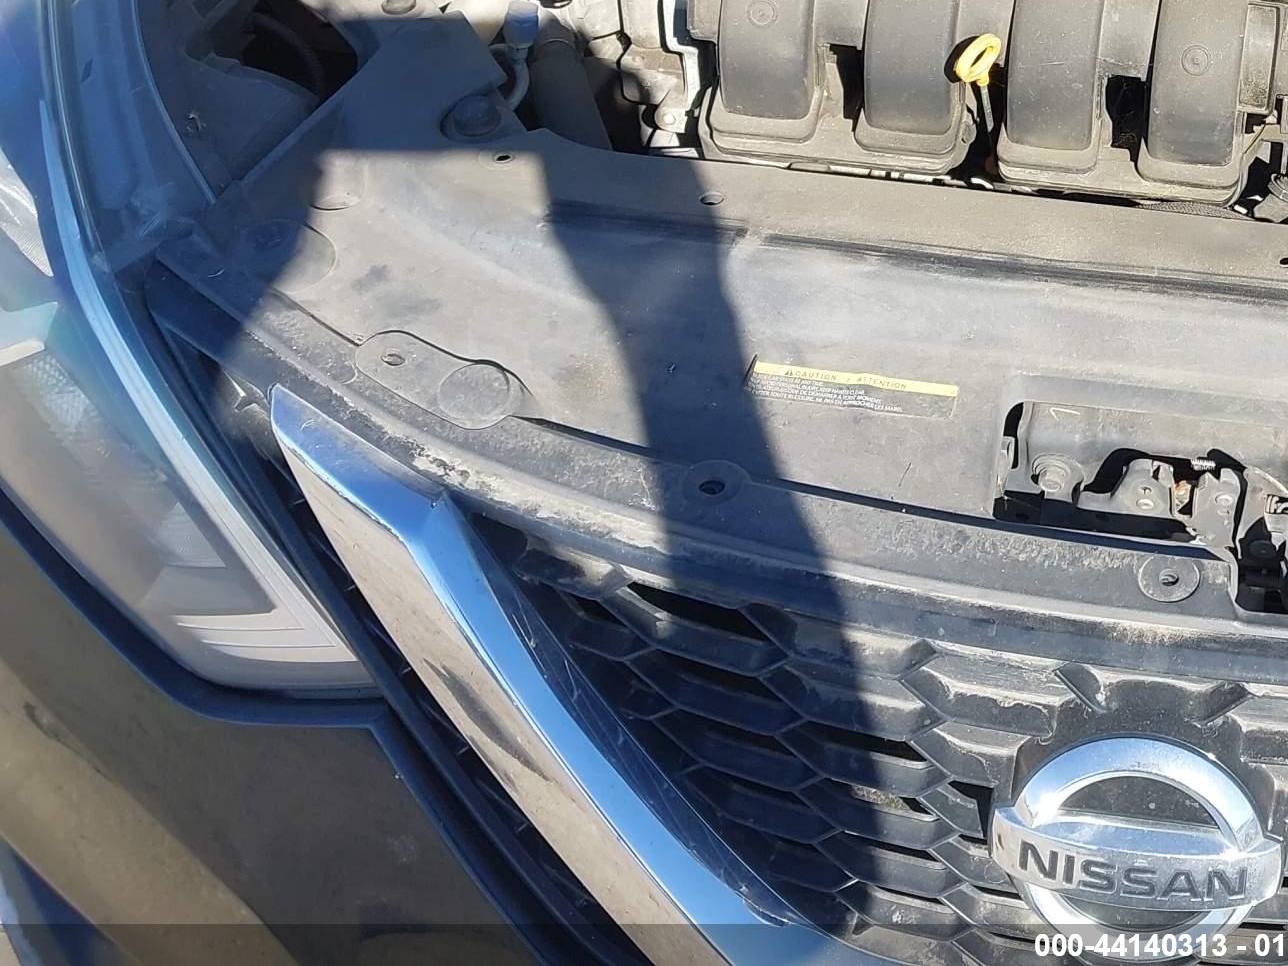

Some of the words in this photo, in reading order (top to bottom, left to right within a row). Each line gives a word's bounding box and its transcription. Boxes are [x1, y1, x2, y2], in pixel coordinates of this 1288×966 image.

[795, 370, 837, 381] CAUTION
[857, 376, 907, 390] ATTENTION
[1018, 840, 1248, 902] NISSAN
